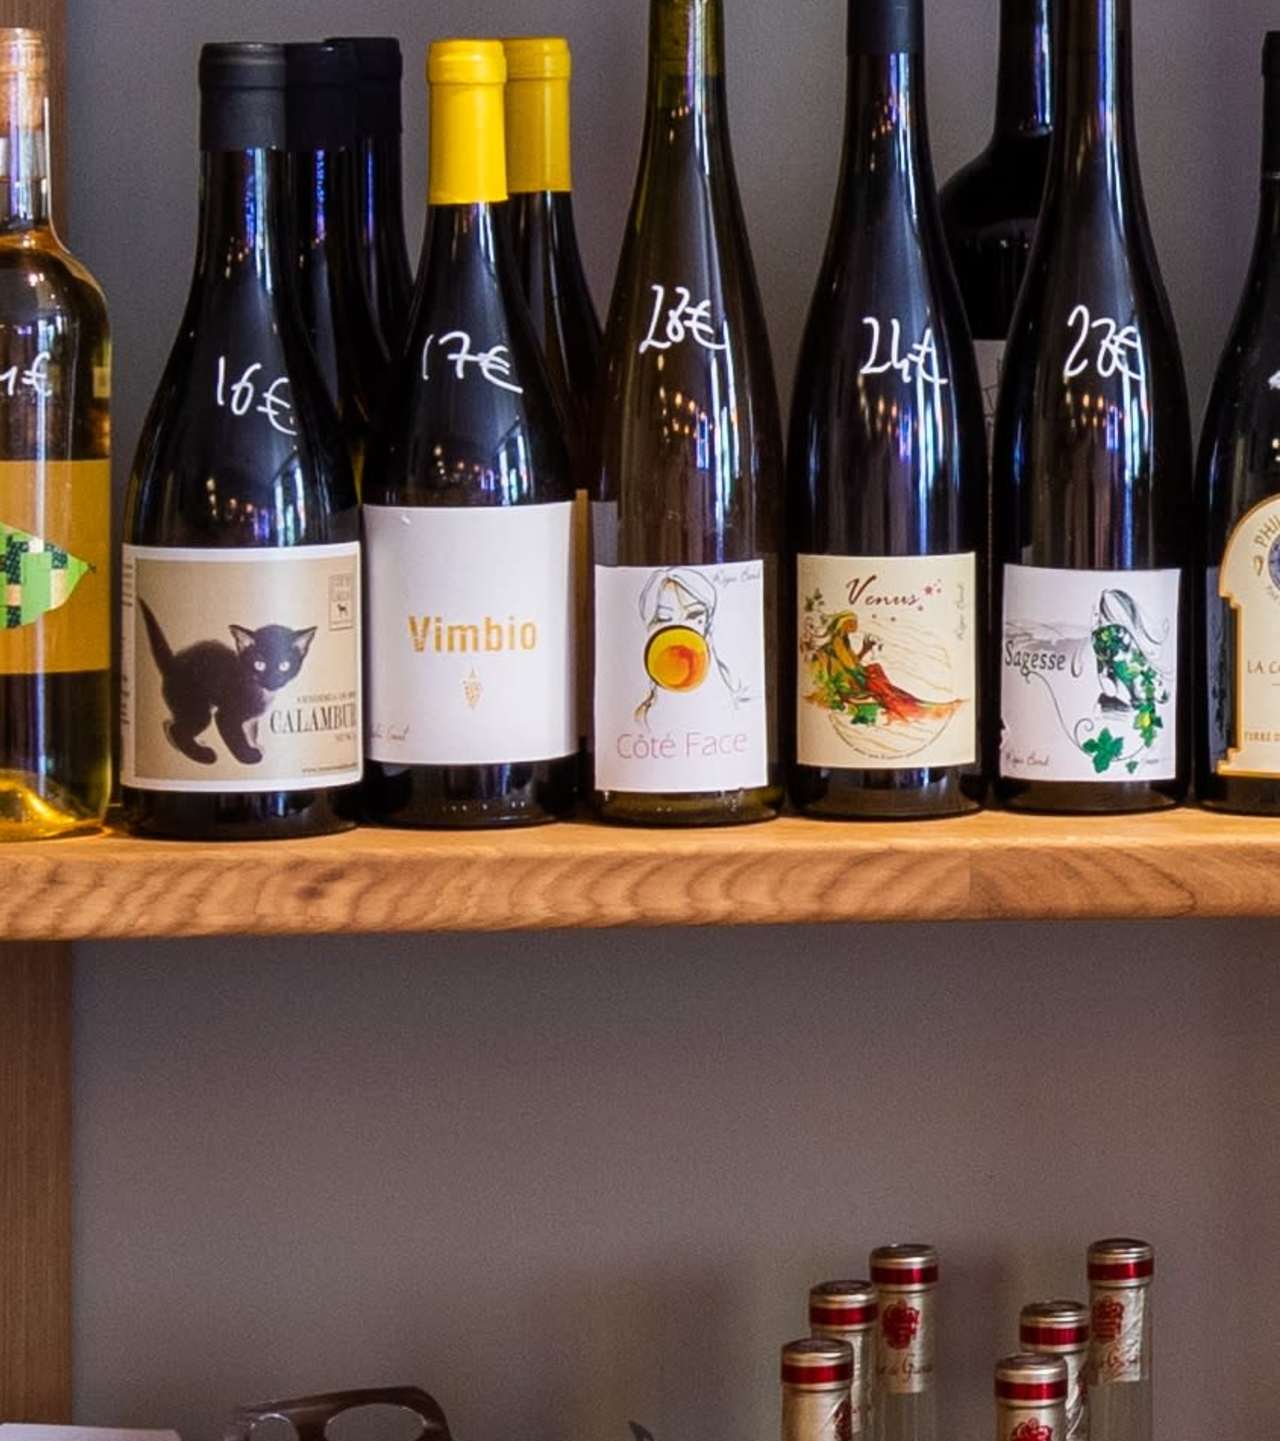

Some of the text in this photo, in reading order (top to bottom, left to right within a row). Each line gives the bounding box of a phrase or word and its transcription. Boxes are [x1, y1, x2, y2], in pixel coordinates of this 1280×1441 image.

[420, 331, 524, 394] 17€
[215, 354, 300, 437] 16€
[845, 573, 920, 608] Venus
[407, 614, 538, 653] Vimbio
[1004, 639, 1067, 684] Sagesse
[616, 731, 749, 760] Côté Face
